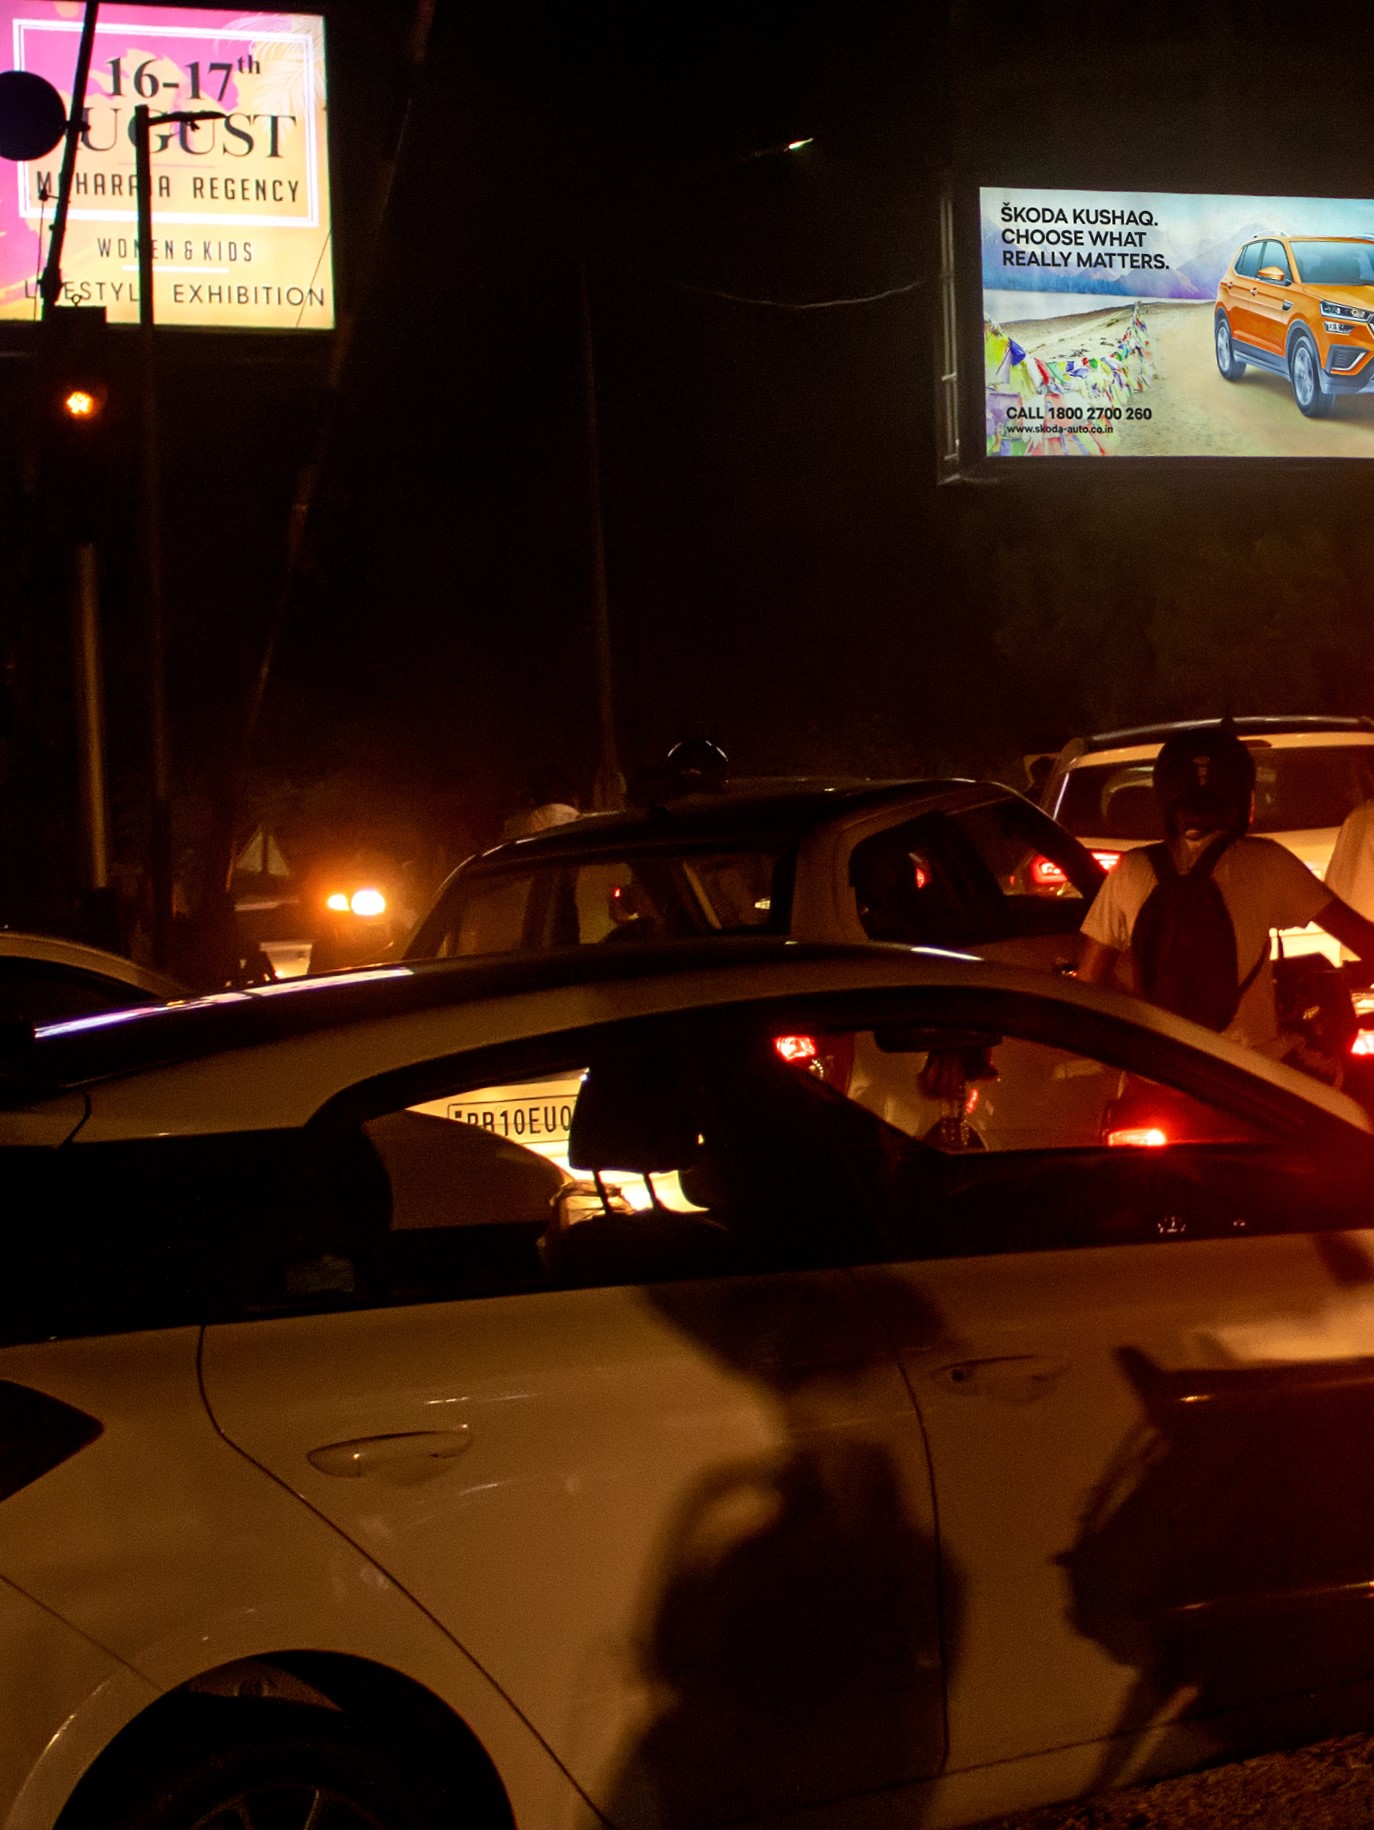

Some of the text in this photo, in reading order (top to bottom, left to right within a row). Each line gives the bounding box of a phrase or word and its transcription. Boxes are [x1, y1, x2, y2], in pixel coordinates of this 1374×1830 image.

[77, 106, 297, 158] UGUST
[37, 171, 299, 202] MHARAA REGENCY
[1000, 202, 1158, 226] ŠKODA KUSHAQ.
[1001, 228, 1147, 247] CHOOSE WHAT
[204, 241, 253, 262] KIDS
[1003, 250, 1170, 270] REALLY MATTERS.
[25, 280, 325, 307] LESTYL EXHIBITION
[1006, 407, 1153, 420] CALL 1800 2700 260
[1006, 424, 1114, 434] www.skoda-auto.co.in
